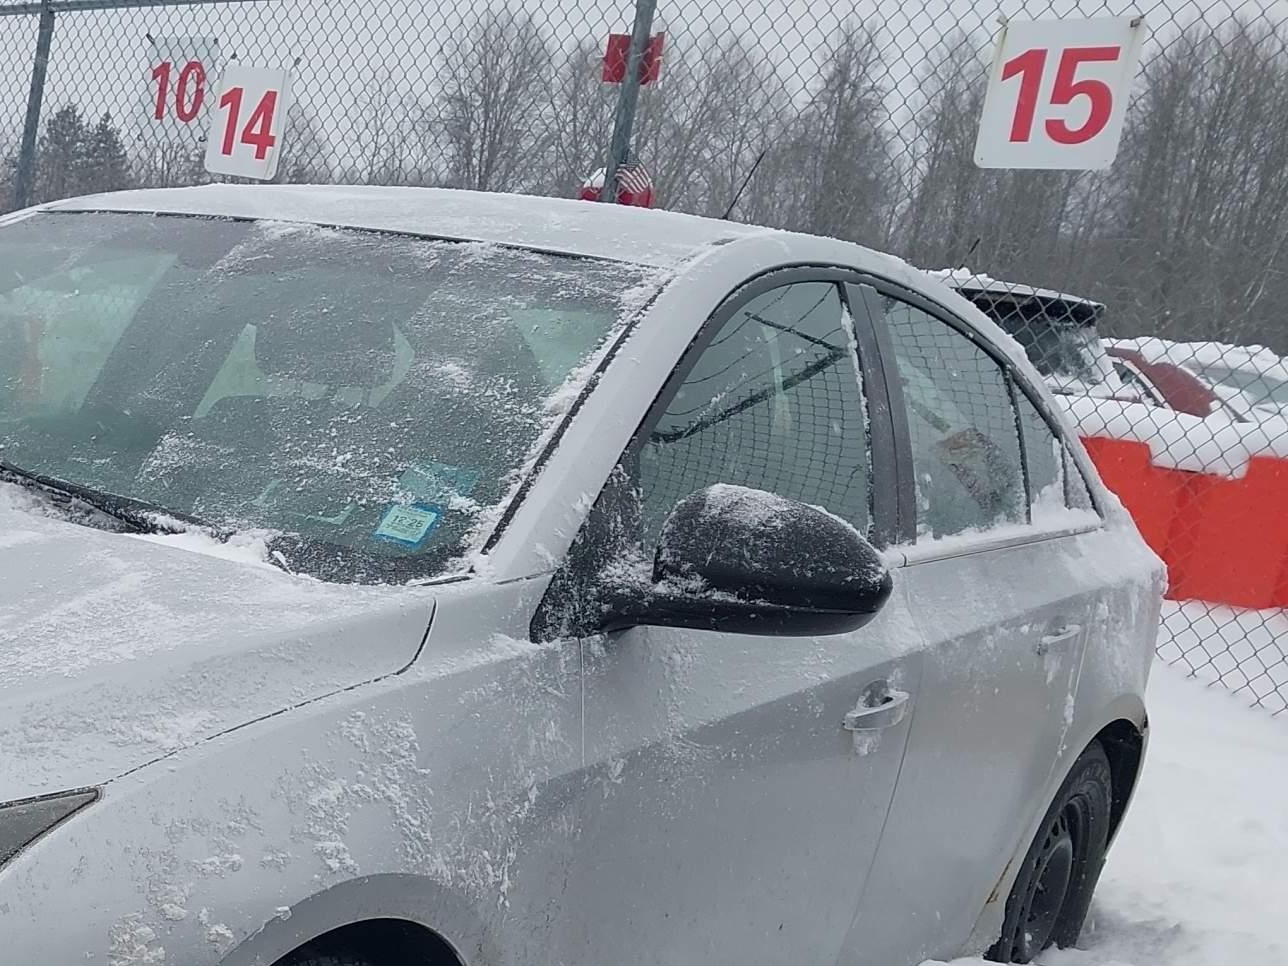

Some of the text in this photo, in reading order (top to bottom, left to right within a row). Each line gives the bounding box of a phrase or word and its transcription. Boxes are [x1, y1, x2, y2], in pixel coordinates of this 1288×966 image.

[152, 61, 206, 122] 10
[219, 87, 278, 160] 14
[1001, 46, 1121, 145] 15
